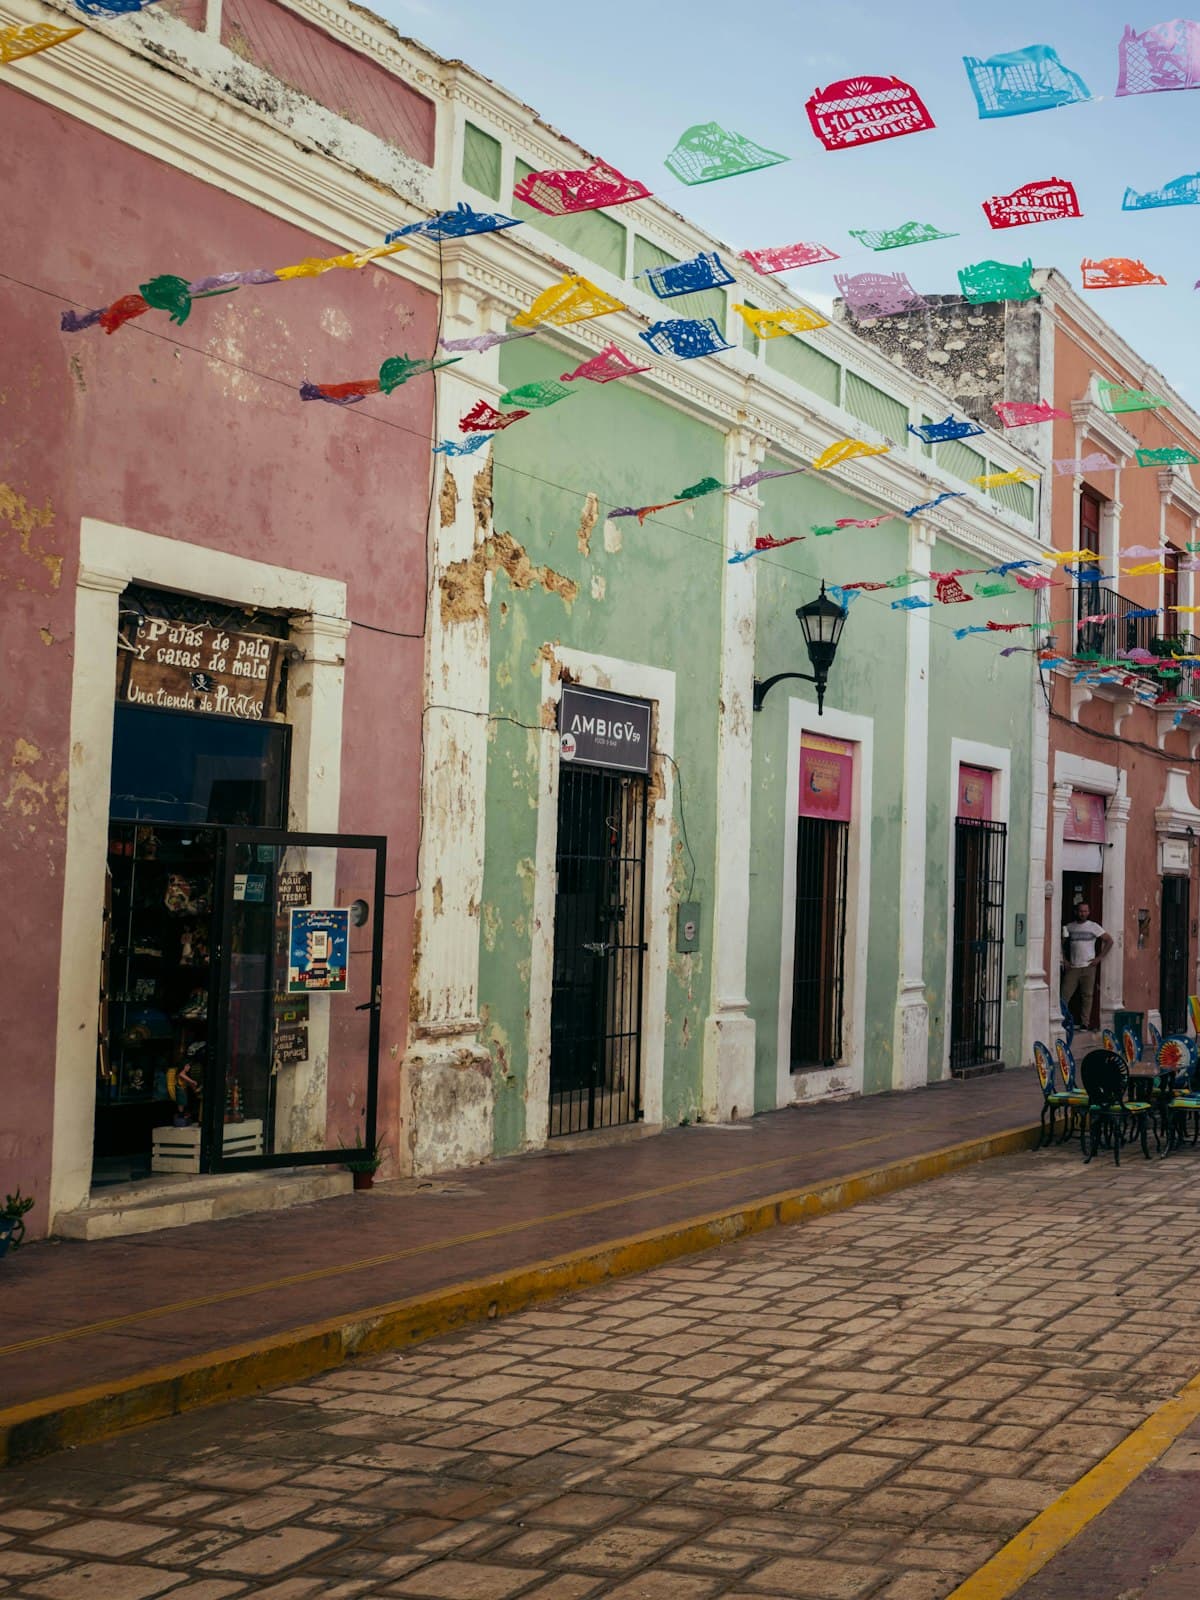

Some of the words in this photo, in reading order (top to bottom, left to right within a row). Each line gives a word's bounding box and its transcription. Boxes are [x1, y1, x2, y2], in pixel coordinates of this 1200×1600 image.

[145, 622, 203, 647] Patas
[212, 631, 230, 651] de
[236, 639, 270, 660] palo
[157, 647, 201, 669] caras
[208, 652, 226, 673] de
[232, 659, 268, 680] malo
[127, 679, 154, 705] Una
[156, 687, 195, 711] tienda
[200, 695, 213, 713] de
[214, 685, 264, 720] PIRATAS
